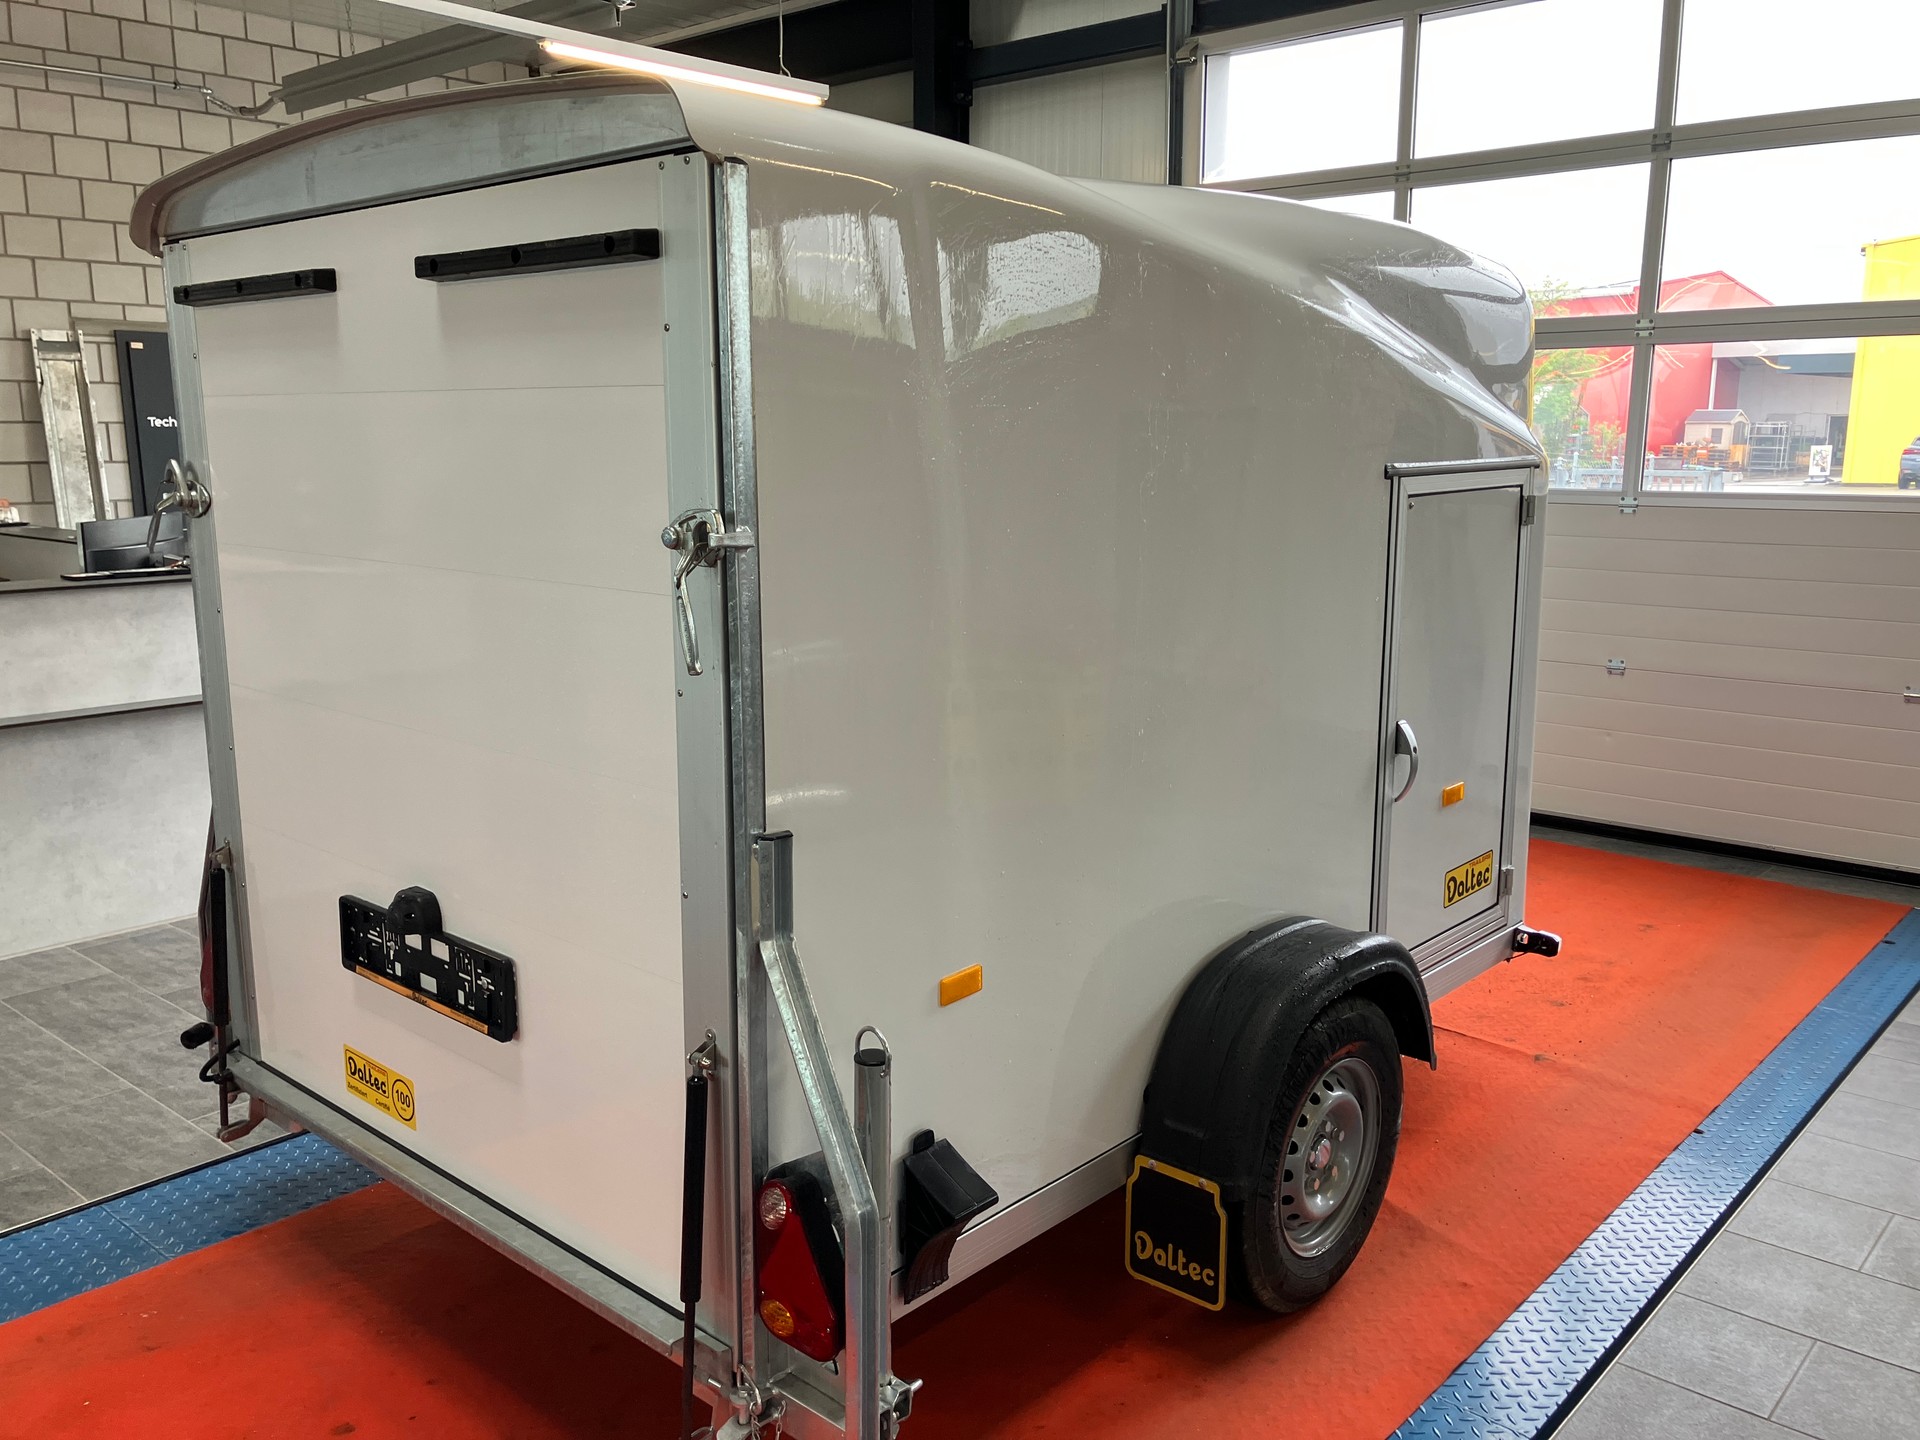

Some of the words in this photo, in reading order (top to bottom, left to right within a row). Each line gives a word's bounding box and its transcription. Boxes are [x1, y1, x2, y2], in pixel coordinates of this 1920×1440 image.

[1447, 867, 1490, 903] Daltec
[347, 1056, 387, 1095] Daltec
[395, 1089, 411, 1109] 100
[1134, 1230, 1215, 1287] Daltec
